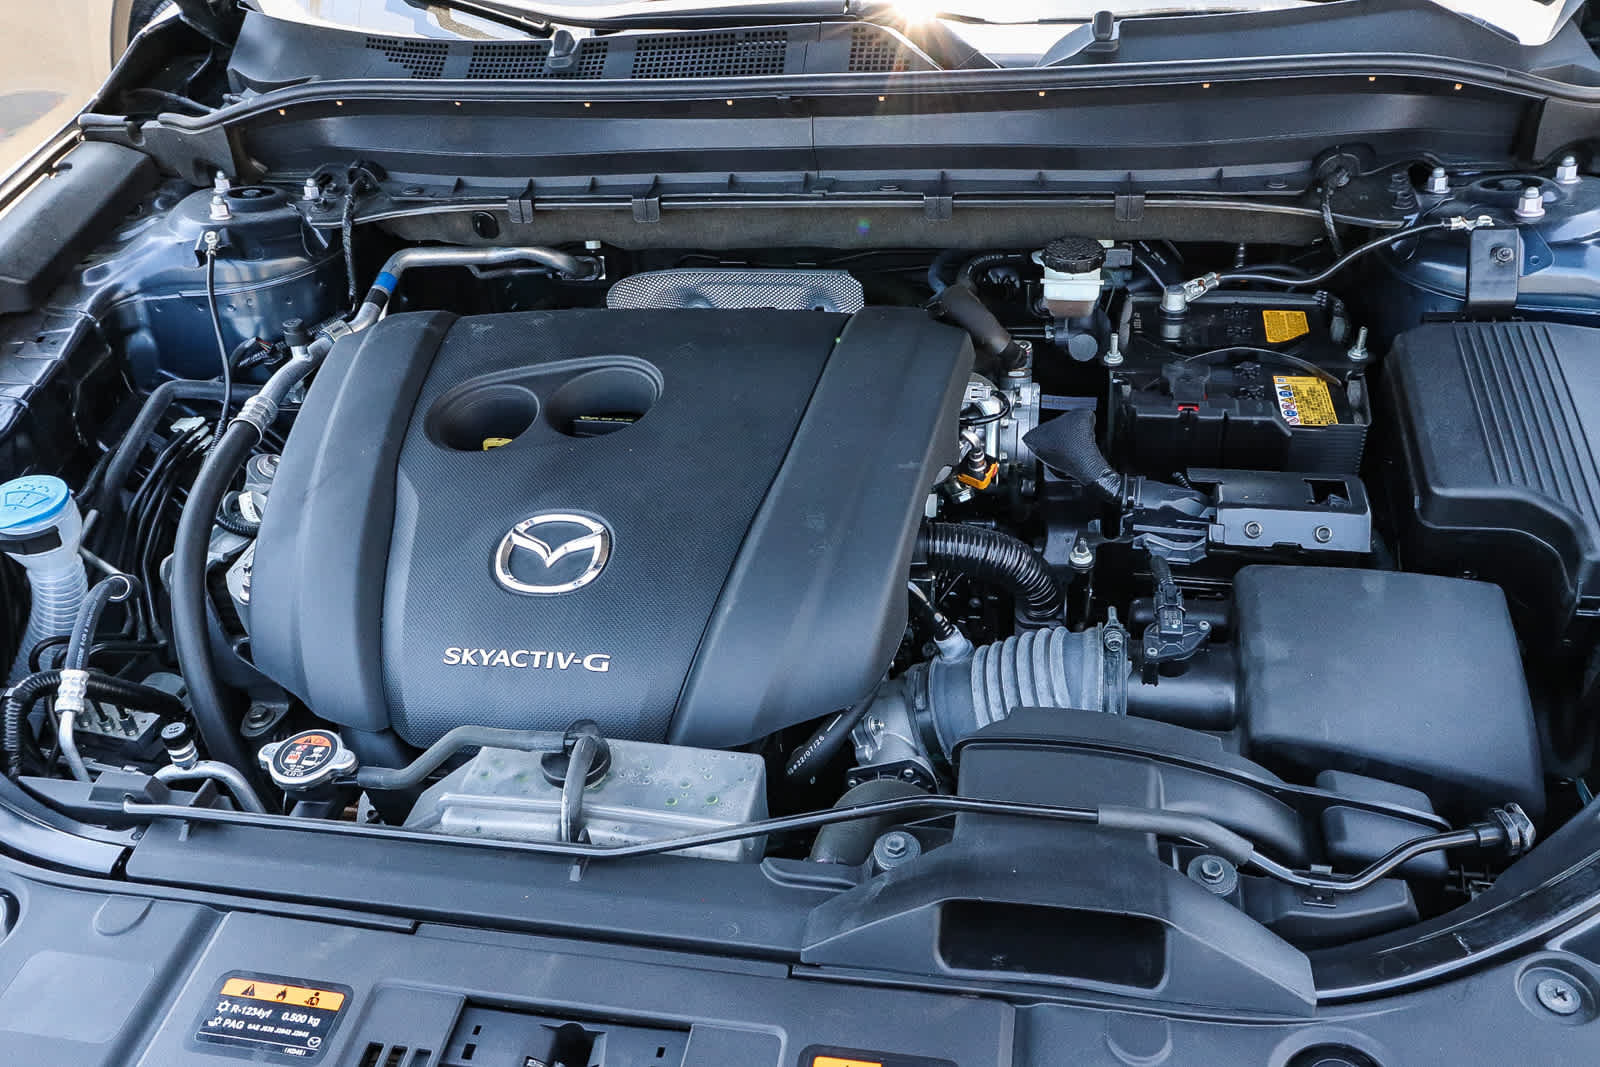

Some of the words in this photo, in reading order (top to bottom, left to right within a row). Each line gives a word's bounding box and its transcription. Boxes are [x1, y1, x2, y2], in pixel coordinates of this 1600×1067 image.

[443, 647, 611, 672] SKYACTIV-G
[222, 1018, 245, 1030] PAG
[230, 1004, 273, 1019] R-1234yf
[308, 1015, 320, 1027] kg
